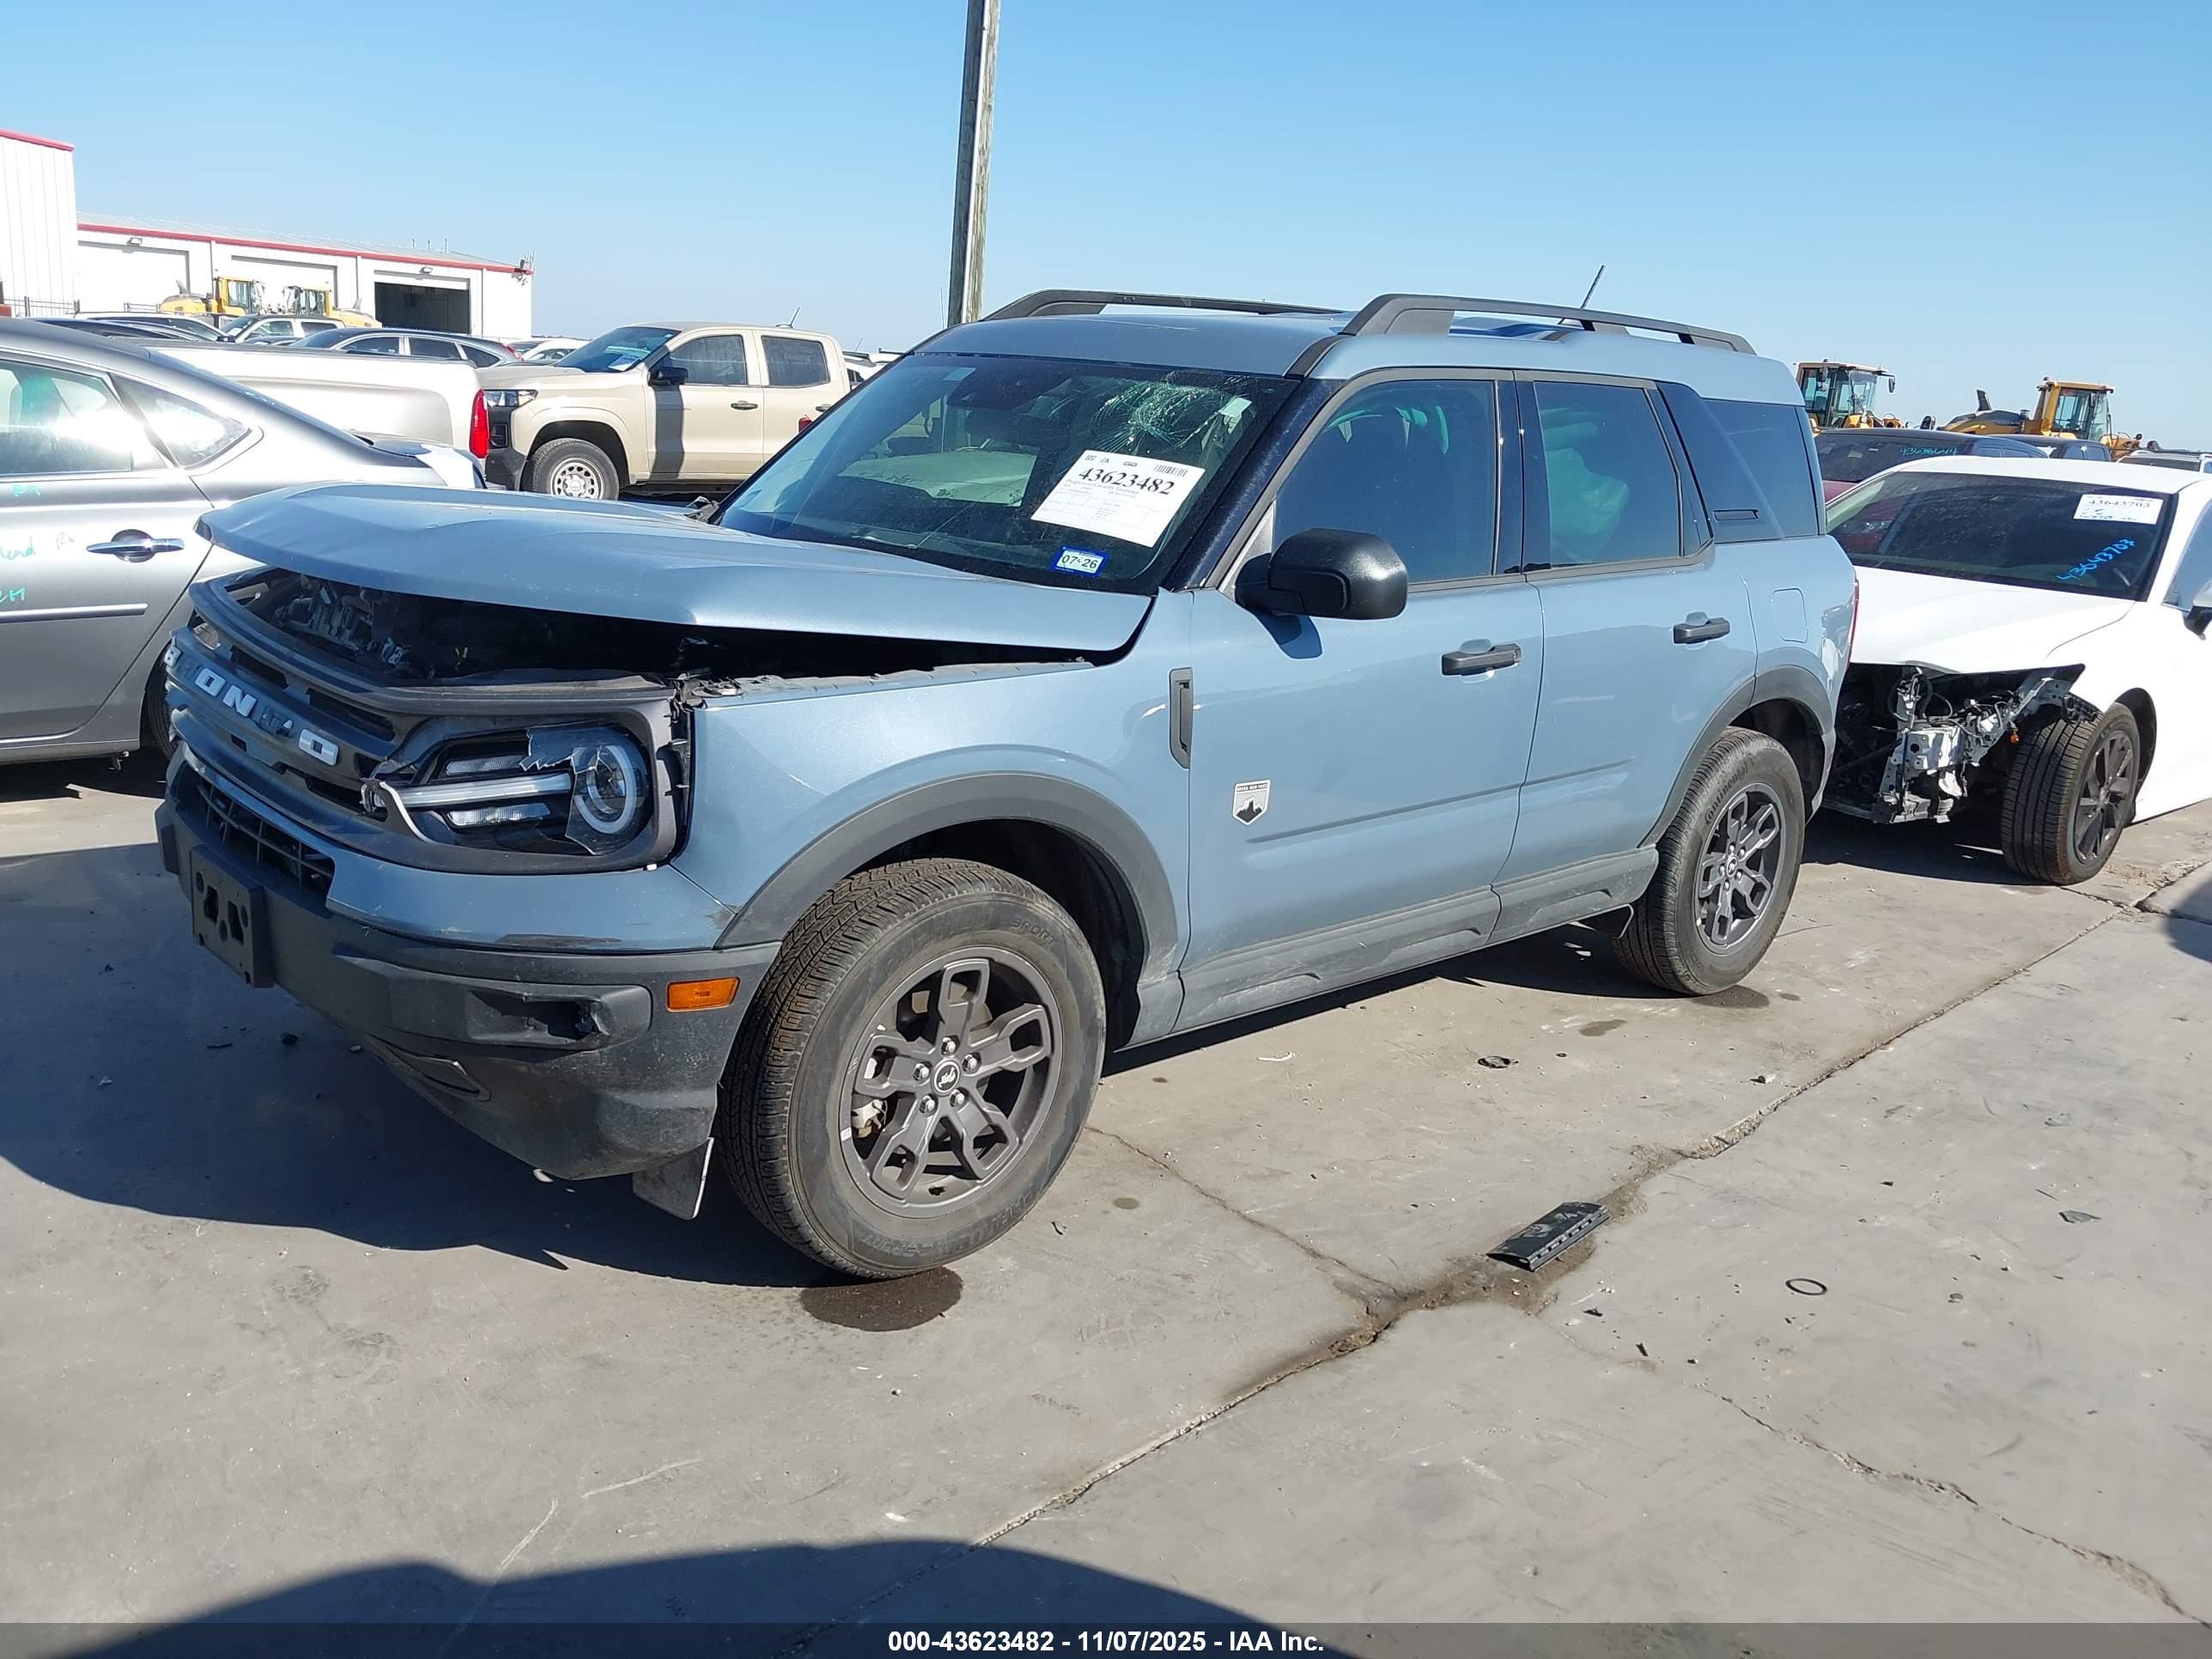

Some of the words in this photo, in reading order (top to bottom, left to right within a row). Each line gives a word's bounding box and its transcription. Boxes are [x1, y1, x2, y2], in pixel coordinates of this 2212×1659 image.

[1079, 467, 1176, 495] 43623482
[2056, 538, 2136, 580] 43643703
[164, 644, 339, 766] BONO
[1704, 761, 1751, 825] Continental
